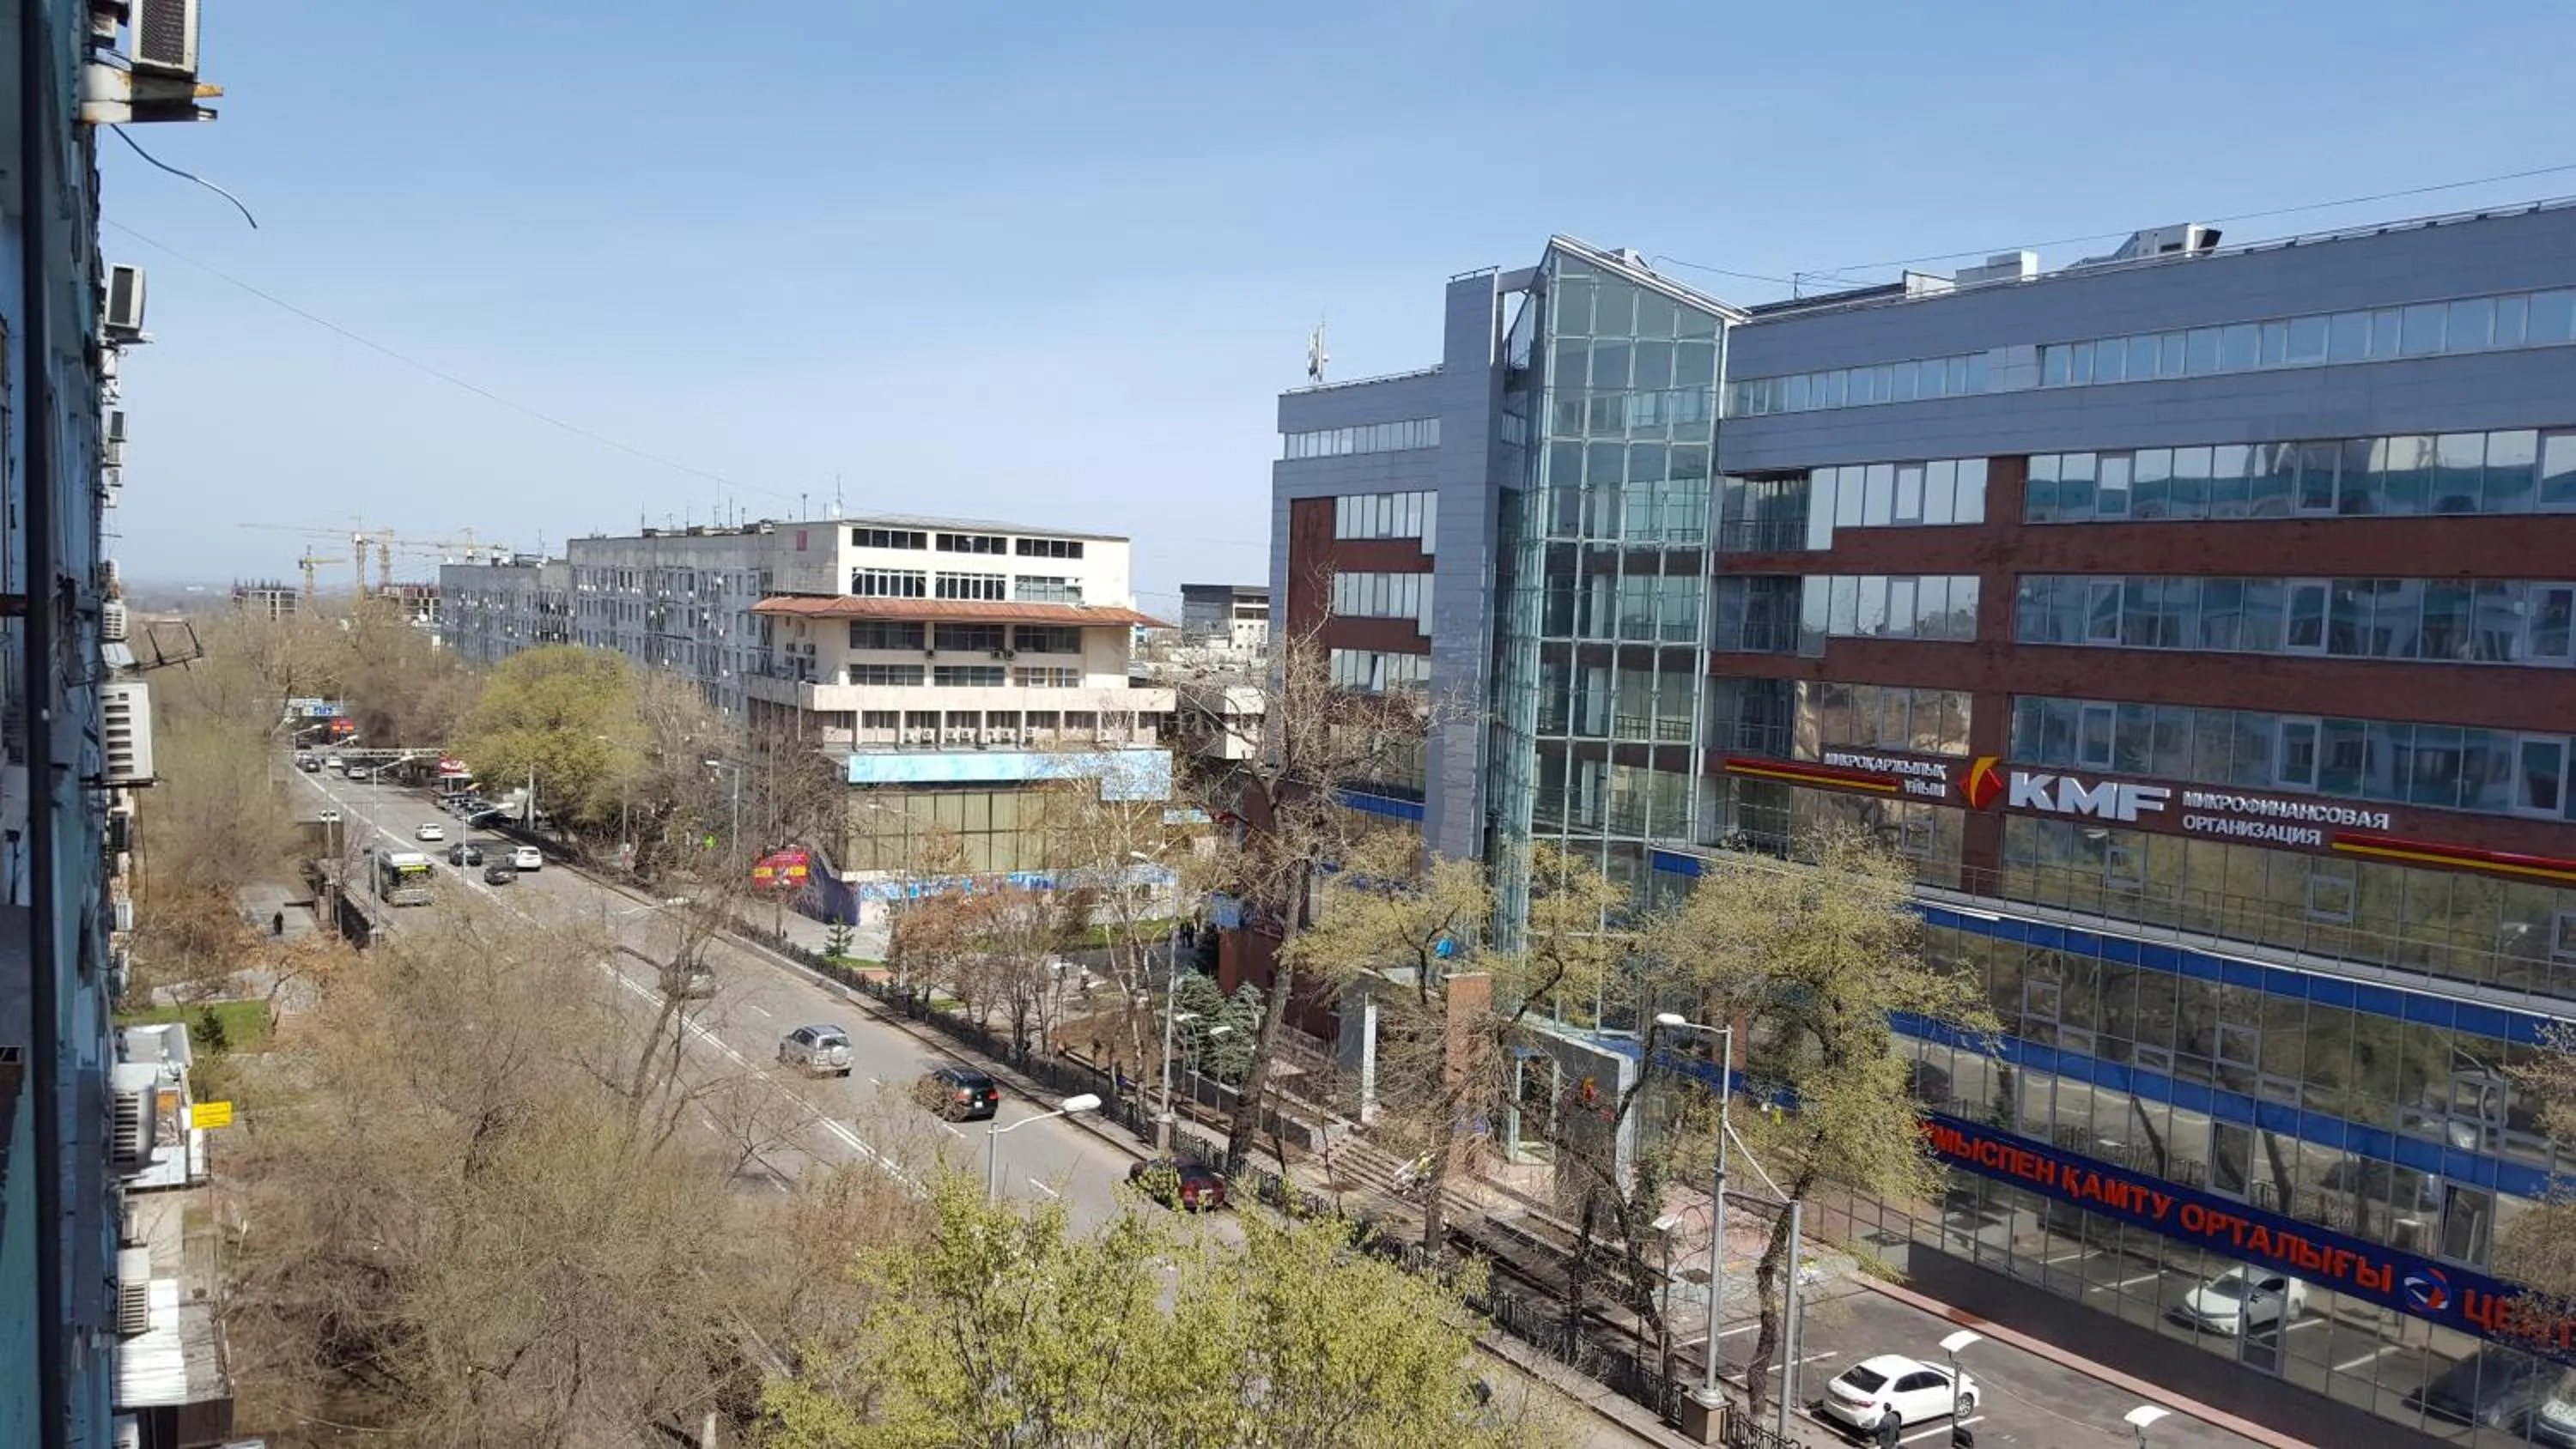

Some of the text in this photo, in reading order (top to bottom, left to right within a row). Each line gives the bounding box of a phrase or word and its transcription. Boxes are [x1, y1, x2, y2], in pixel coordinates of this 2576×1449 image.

[2008, 772, 2171, 822] KMF
[2183, 791, 2390, 830] МИКРОФИНАНСОВАЯ
[2183, 815, 2322, 846] ОРГАНИЗАЦИЯ
[2062, 1164, 2173, 1219] ҚАМТУ
[2179, 1203, 2393, 1294] ОРТАЛЫҒЫ
